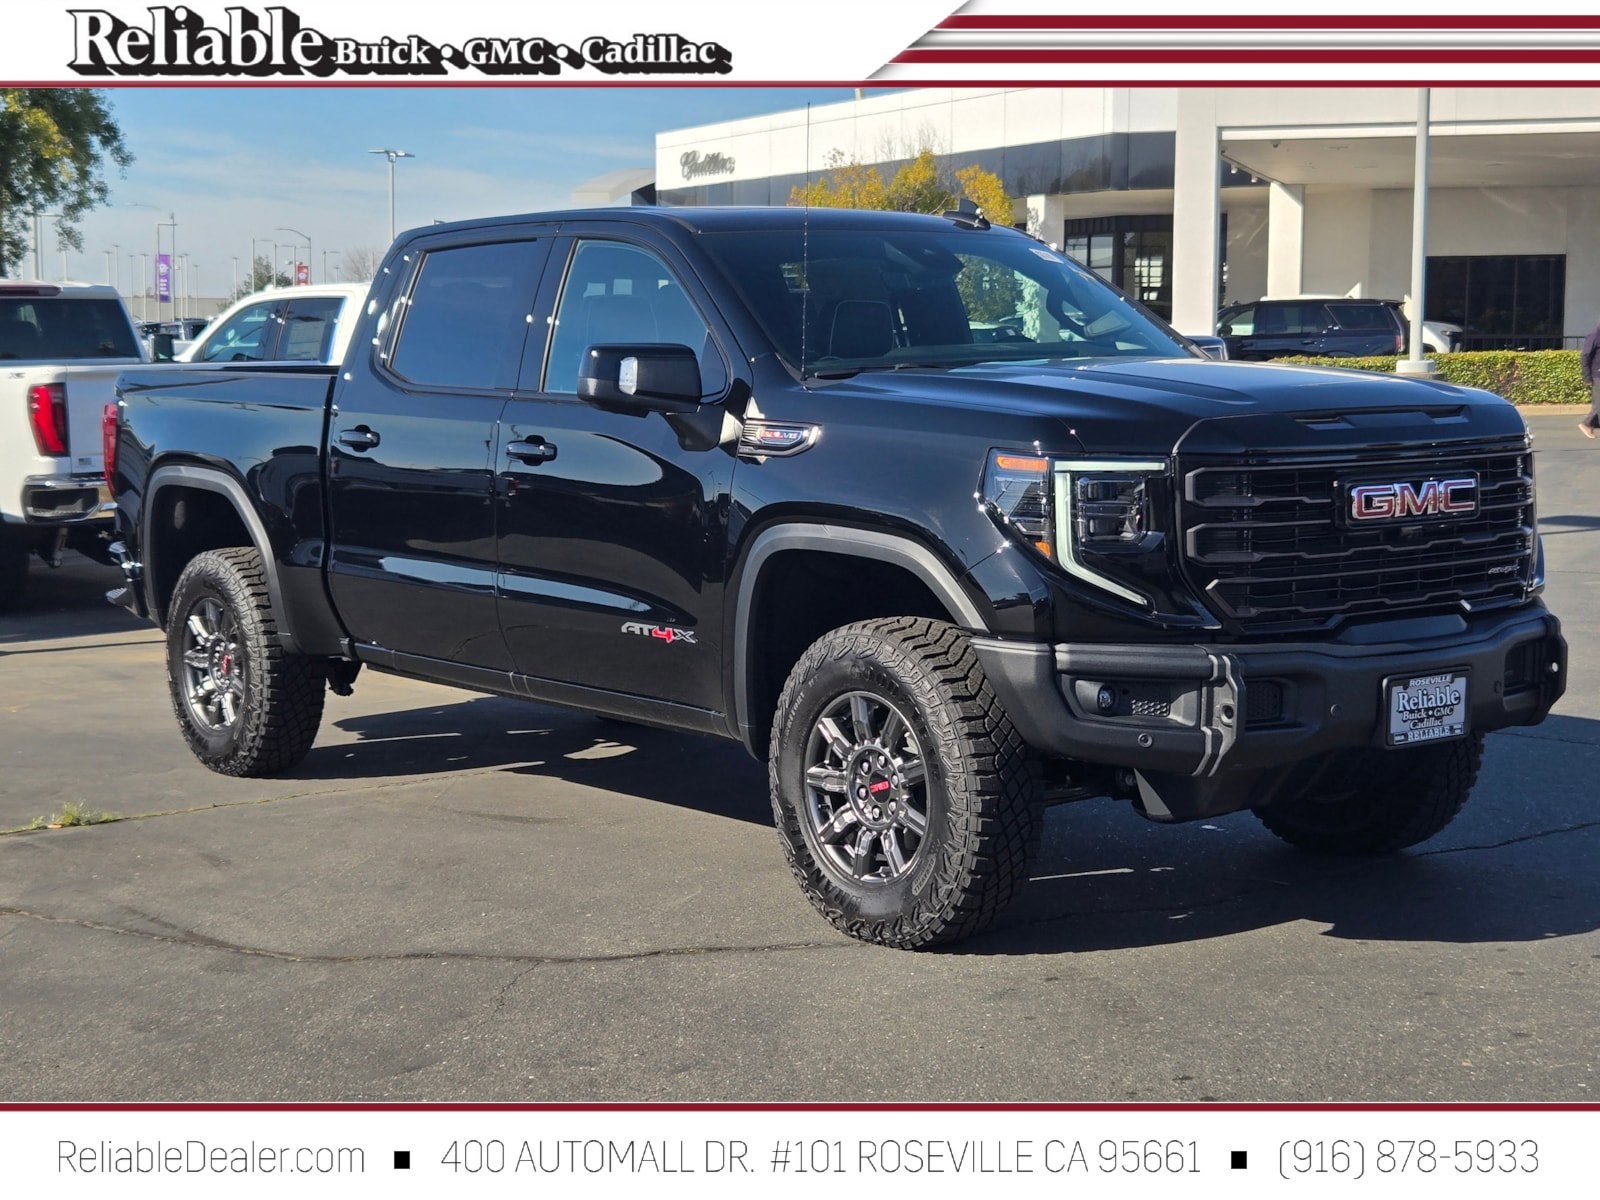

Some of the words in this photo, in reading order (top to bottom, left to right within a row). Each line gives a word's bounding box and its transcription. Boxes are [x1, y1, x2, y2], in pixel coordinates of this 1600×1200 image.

[1351, 479, 1477, 519] GMC
[621, 621, 698, 644] AT4X
[1409, 674, 1452, 687] ROSEVILLE
[1397, 685, 1461, 712] Reliable
[1402, 709, 1427, 721] Buick
[1433, 706, 1454, 717] GMC
[1410, 718, 1443, 730] Cadillac
[1407, 726, 1451, 741] RELIABLE
